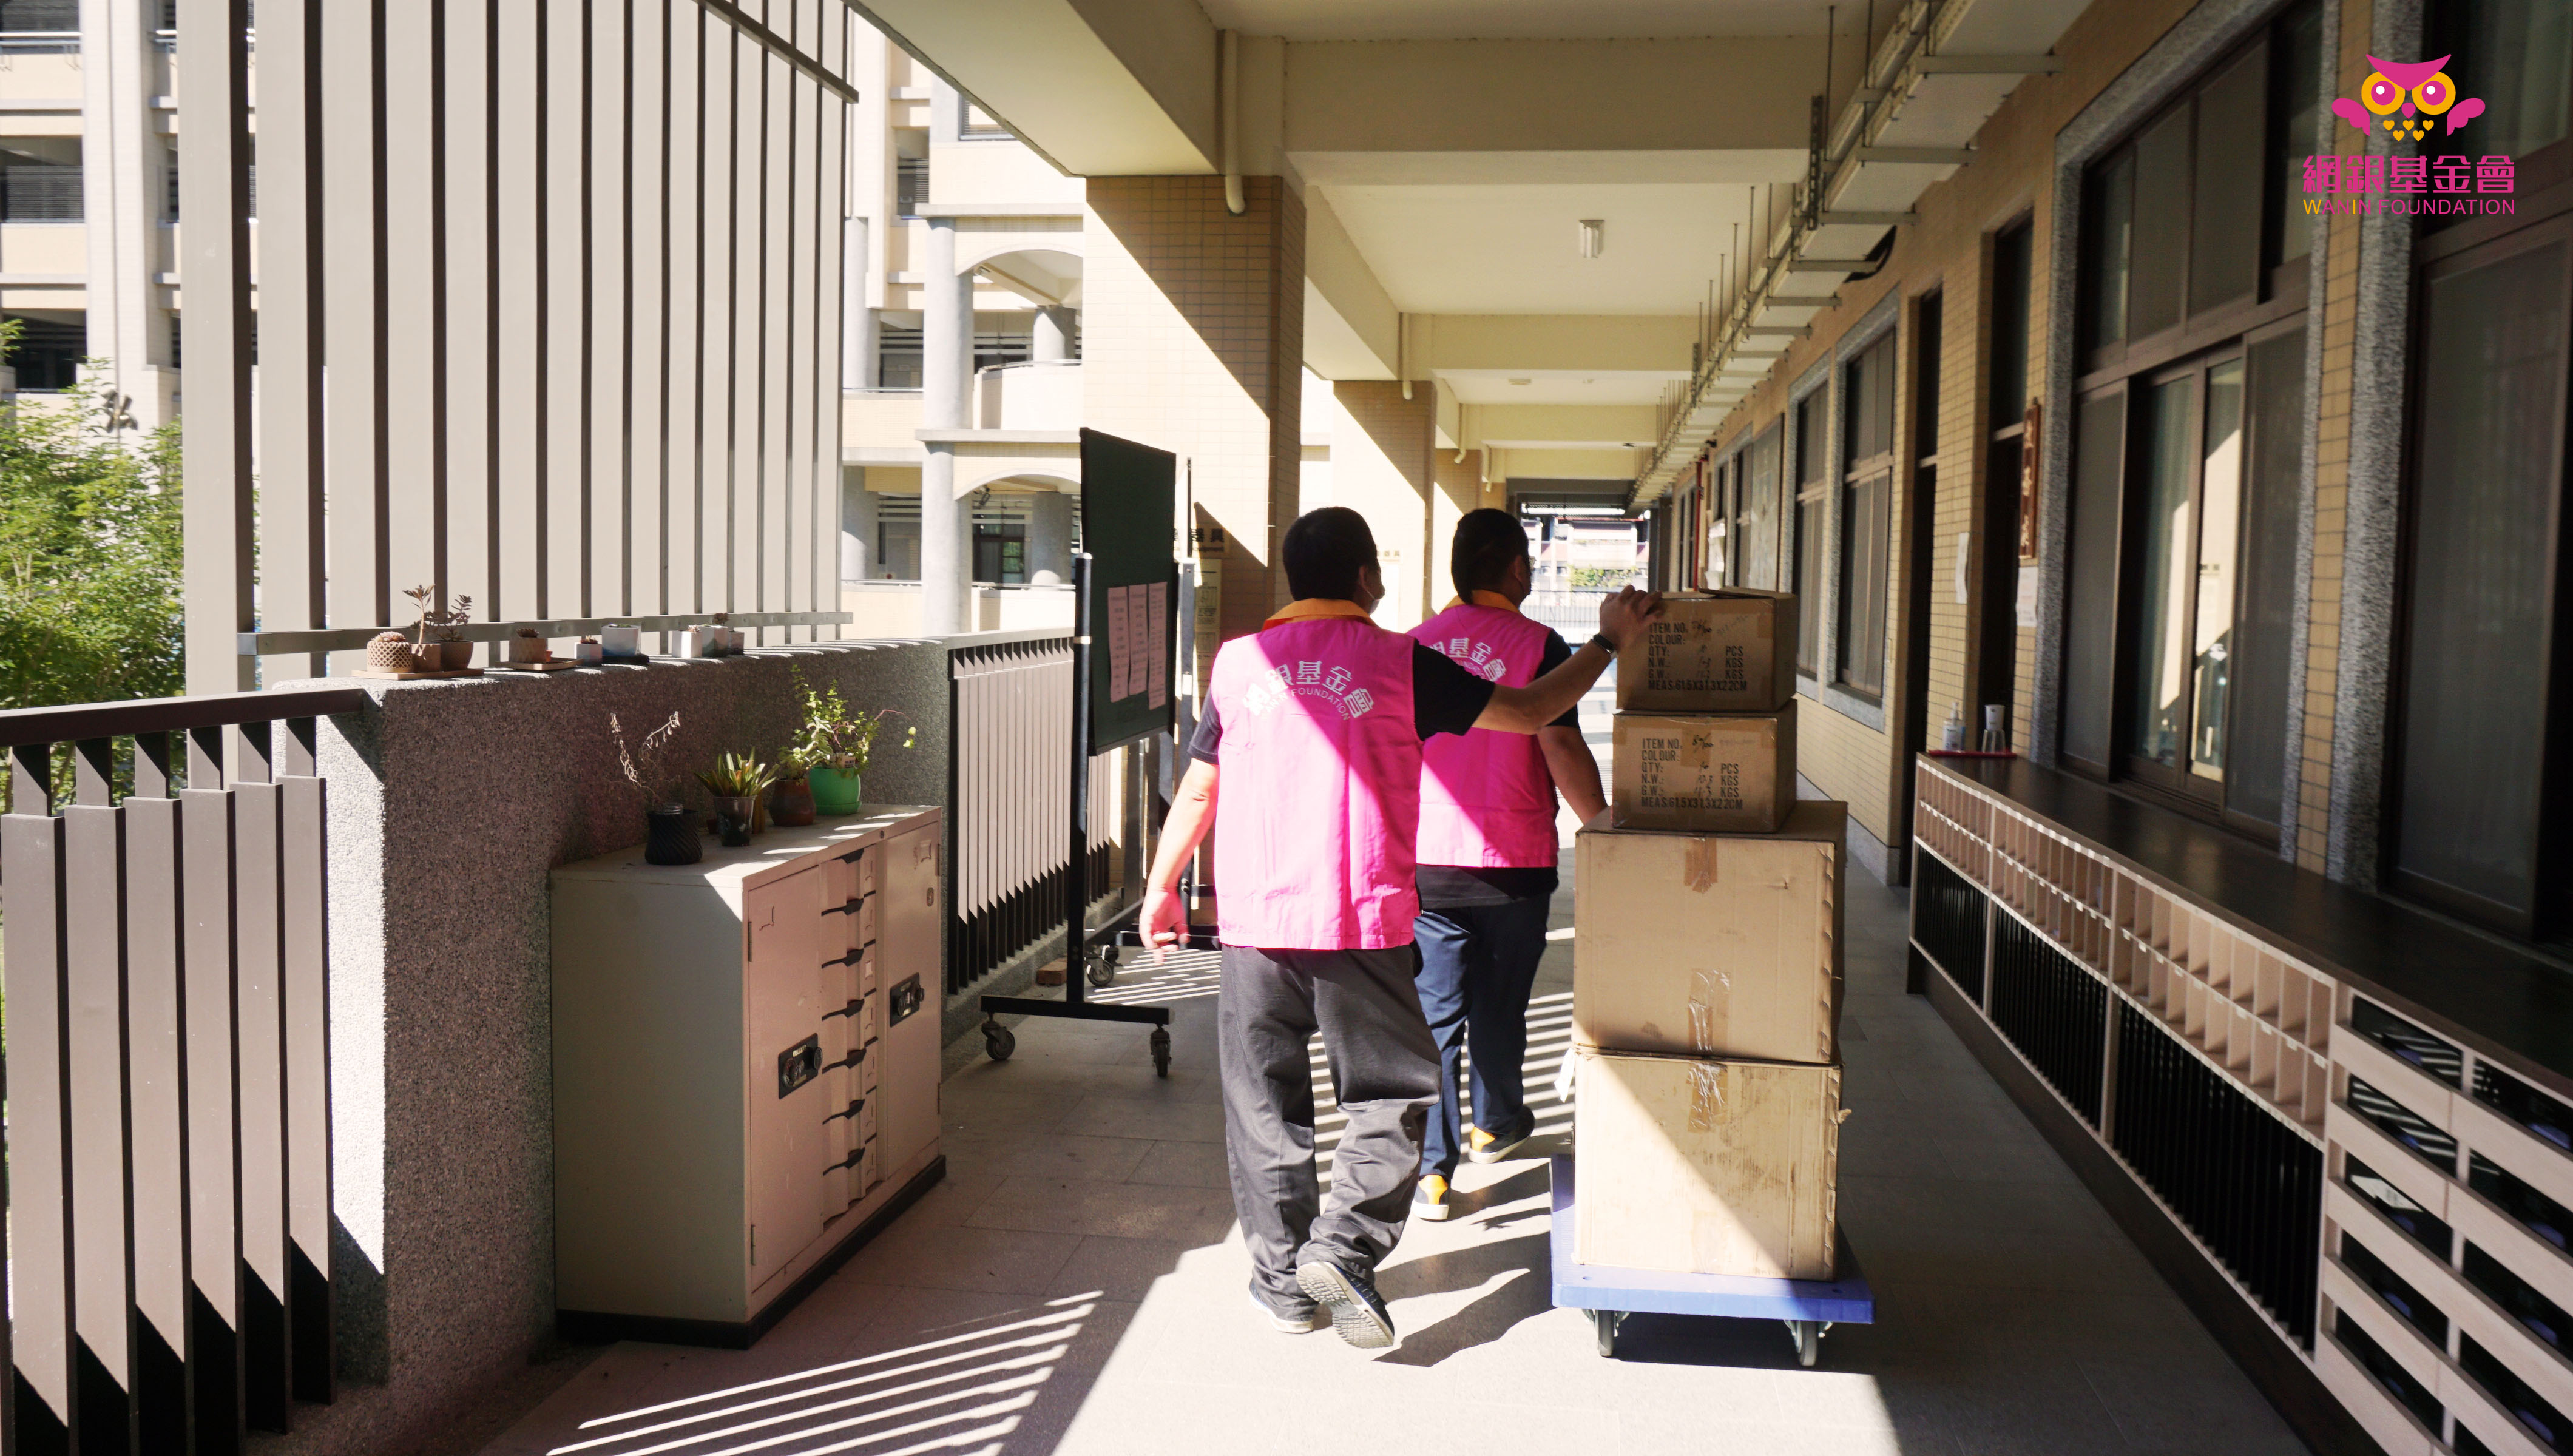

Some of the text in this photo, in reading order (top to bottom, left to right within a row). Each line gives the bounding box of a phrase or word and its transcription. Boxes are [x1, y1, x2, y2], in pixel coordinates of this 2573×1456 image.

[1649, 622, 1670, 633] ITEM
[1725, 645, 1743, 656] PCS
[1725, 658, 1743, 668] KGS
[1725, 669, 1744, 679] KGS
[1291, 687, 1351, 721] FOUNDATION
[1642, 738, 1665, 750] ITEM
[1641, 750, 1680, 761] COLOUR:
[1641, 761, 1664, 773] QTY:
[1720, 763, 1739, 774] PCS
[1720, 775, 1739, 786] KGS
[1720, 787, 1739, 798] KGS
